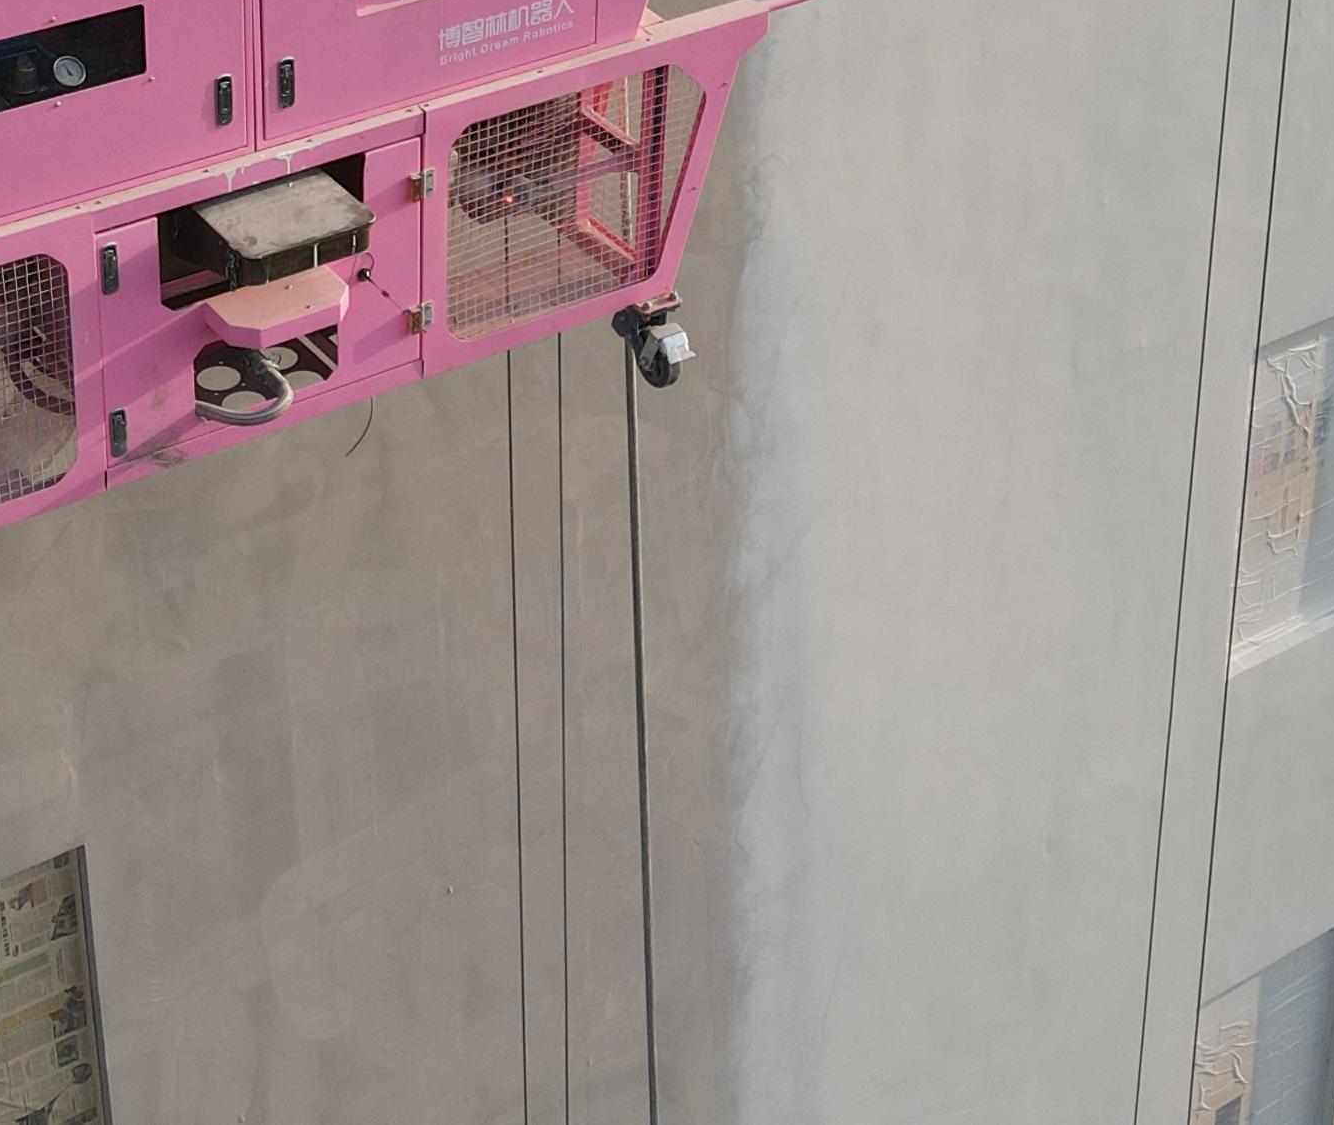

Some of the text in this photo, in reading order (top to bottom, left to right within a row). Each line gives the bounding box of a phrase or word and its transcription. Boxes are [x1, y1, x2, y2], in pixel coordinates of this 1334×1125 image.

[440, 21, 574, 66] Bright Dream Robotics
